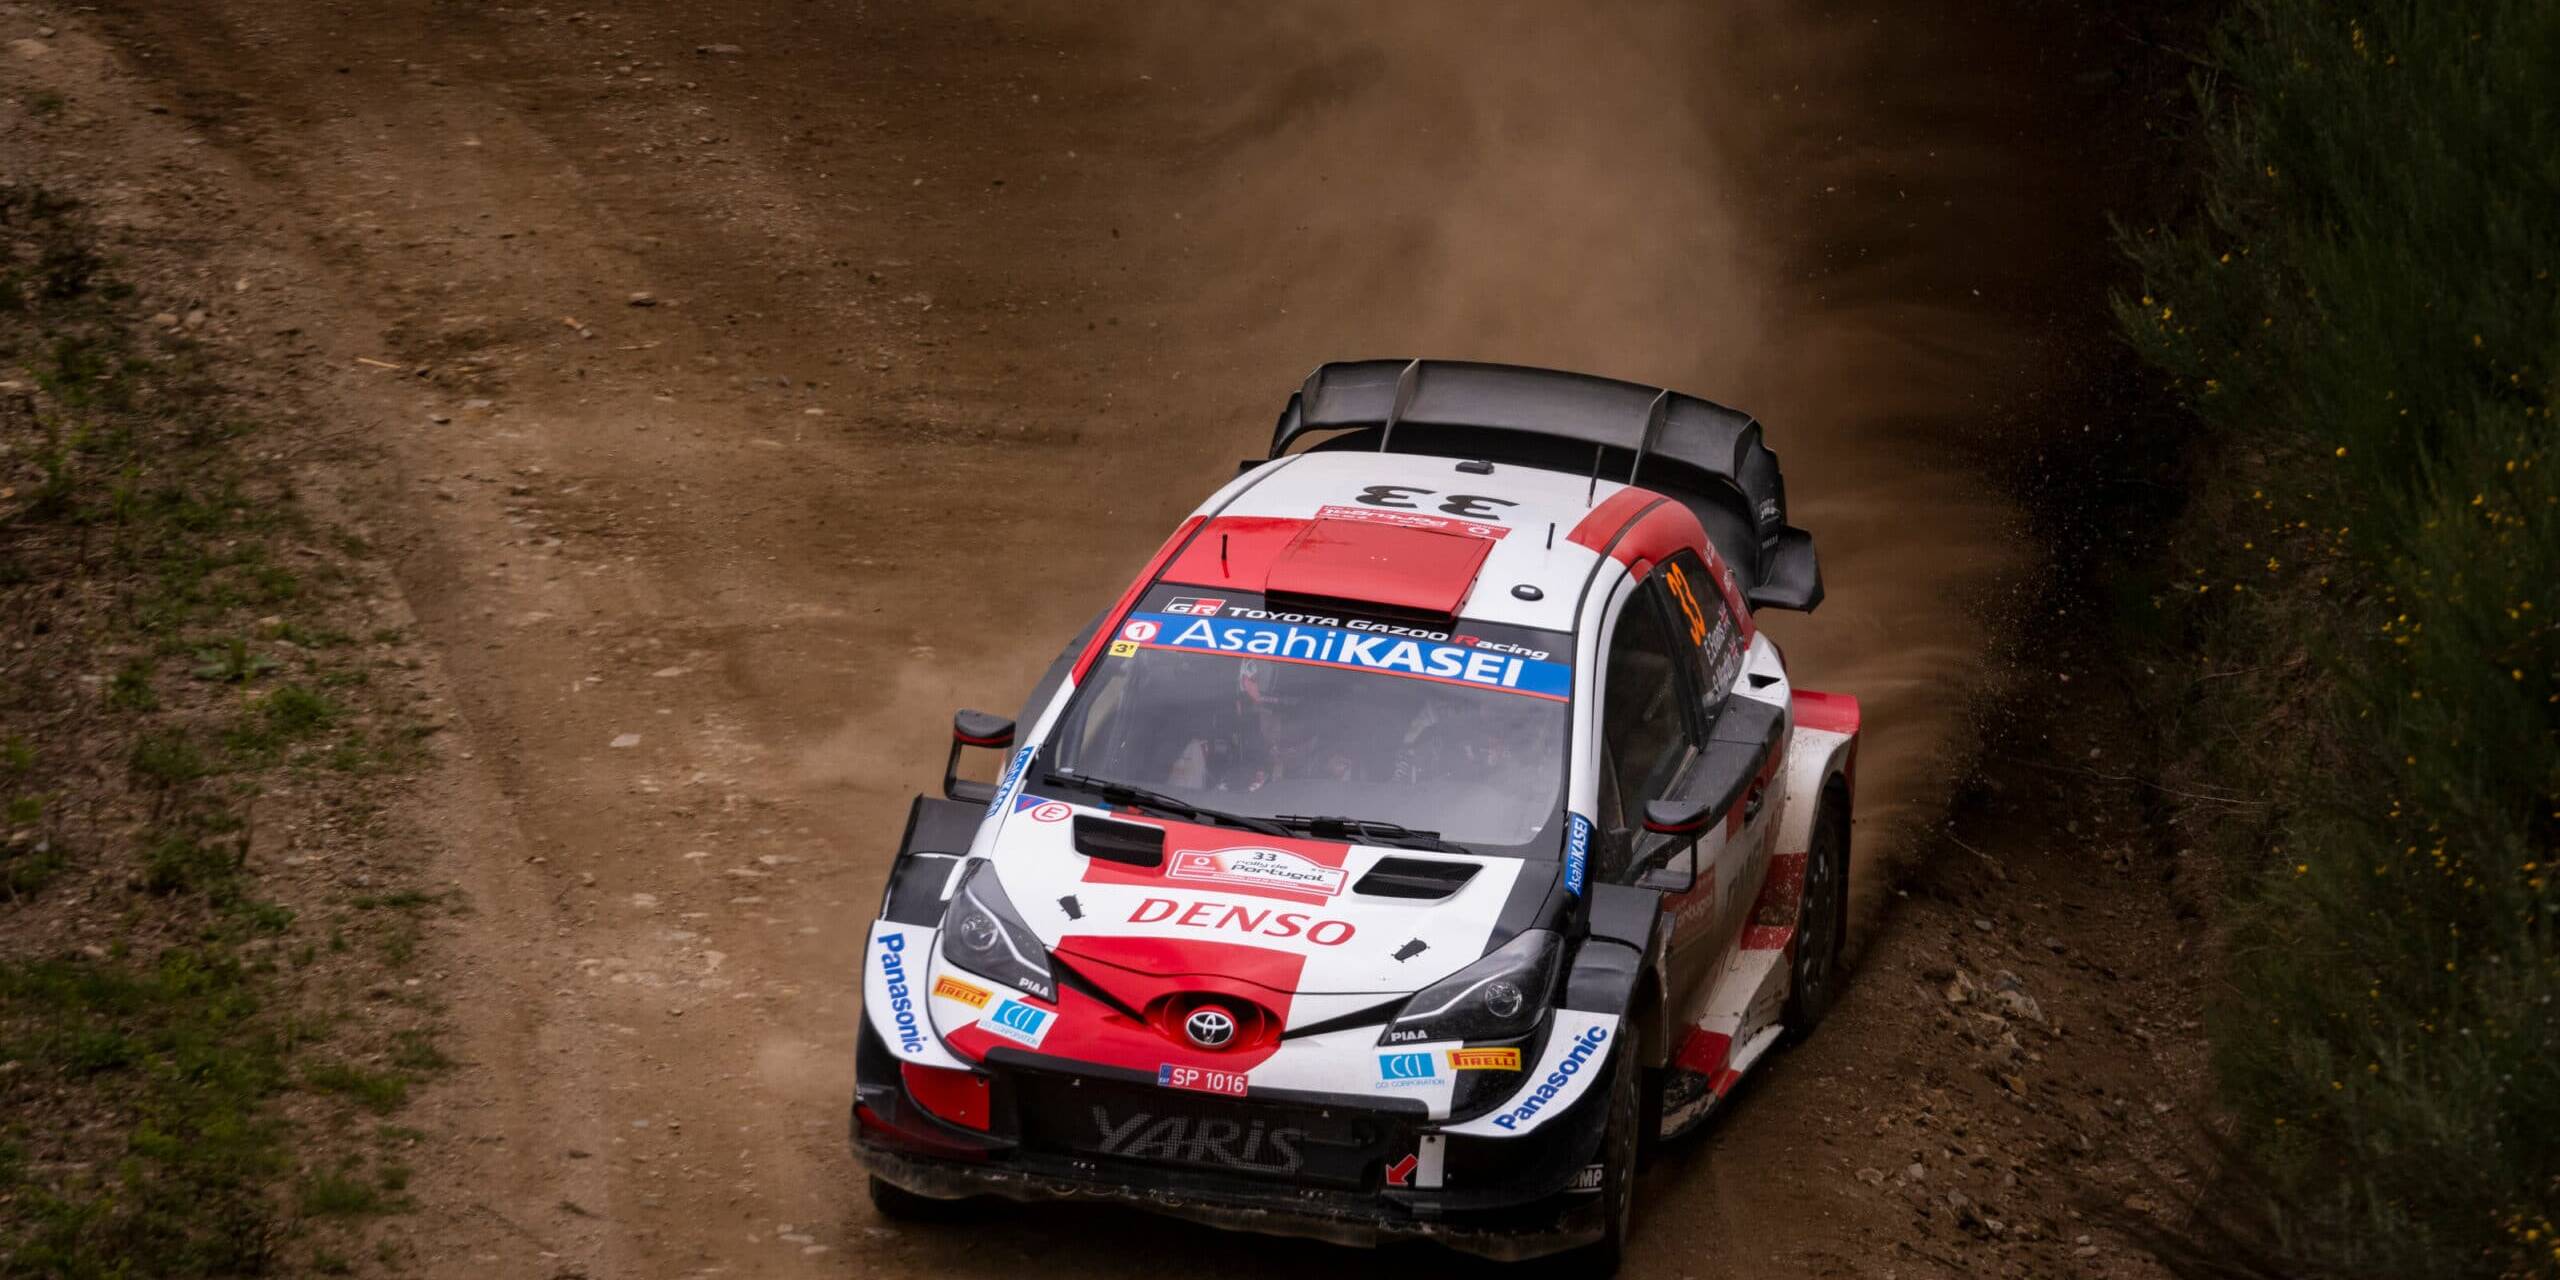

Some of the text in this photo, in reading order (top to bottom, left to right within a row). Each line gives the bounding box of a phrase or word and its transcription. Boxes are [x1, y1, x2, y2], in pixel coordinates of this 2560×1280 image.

[1355, 485, 1520, 520] 33
[1666, 561, 1706, 647] 33
[1166, 603, 1551, 660] GR TOYOTA GAZOO Racing
[1041, 806, 1062, 818] E
[1253, 851, 1277, 862] 33
[1230, 865, 1325, 882] Portugal
[1126, 898, 1356, 946] DENSO
[877, 932, 928, 1053] Panasonic
[935, 977, 988, 1007] PIRELLI
[1019, 977, 1049, 997] PIAA
[1391, 1030, 1427, 1042] PIAA
[1453, 1052, 1517, 1067] PIRELLI
[1172, 1068, 1244, 1093] SP 1016
[1391, 1079, 1445, 1088] CORPORATION
[1493, 1025, 1608, 1130] Panasonic
